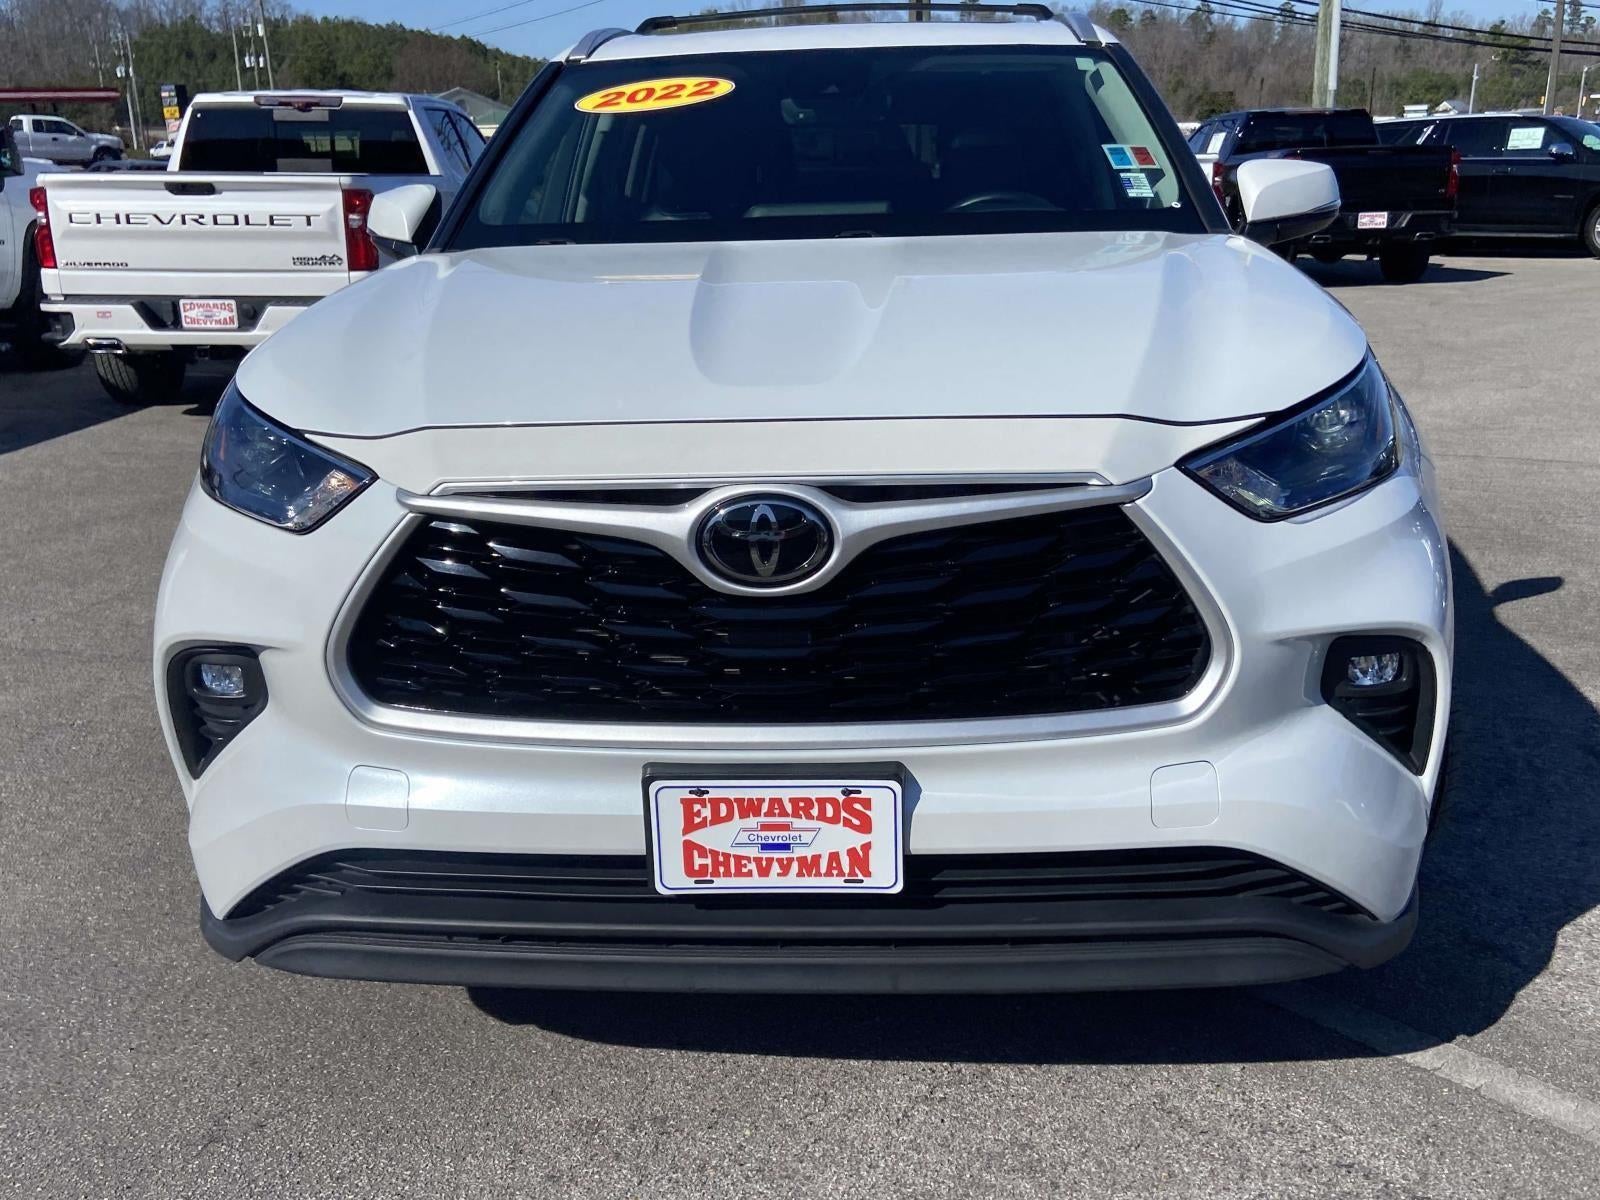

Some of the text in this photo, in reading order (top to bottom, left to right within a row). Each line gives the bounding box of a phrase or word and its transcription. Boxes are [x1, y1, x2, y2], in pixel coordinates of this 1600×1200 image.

[592, 80, 719, 109] 2022
[68, 212, 321, 227] CHEVROLET
[182, 302, 234, 313] EDWARDS
[184, 314, 236, 325] CHEVYMAN
[680, 797, 872, 836] EDWARDS
[747, 833, 802, 844] Chevrolet
[682, 839, 872, 878] CHEVYMAN
